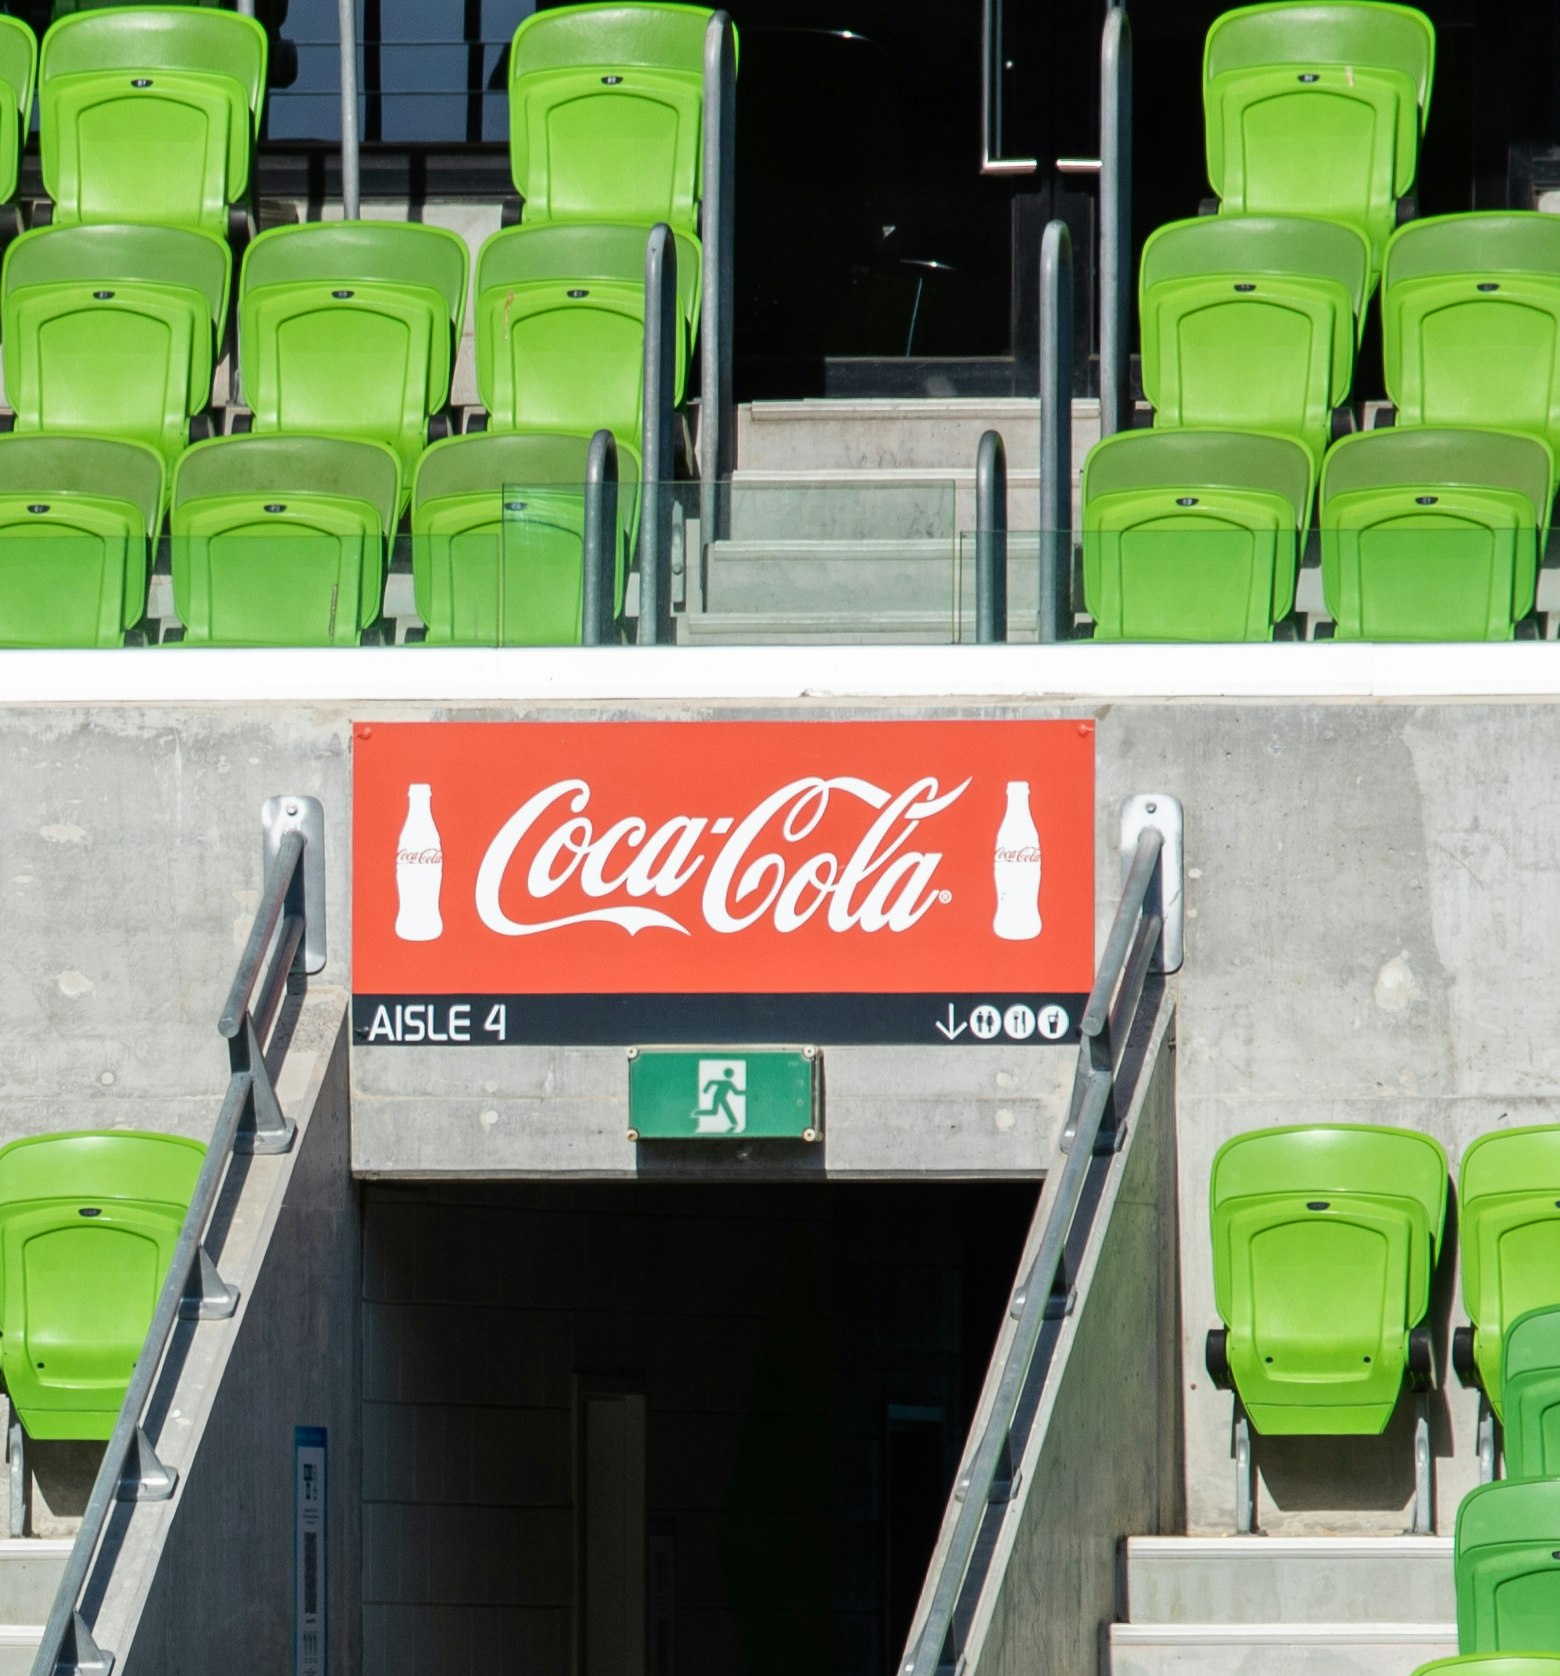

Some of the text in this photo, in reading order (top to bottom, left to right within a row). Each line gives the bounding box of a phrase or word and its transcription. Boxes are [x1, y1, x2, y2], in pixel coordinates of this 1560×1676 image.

[475, 776, 973, 936] Coca-Cola
[368, 1004, 506, 1042] AISLE 4
